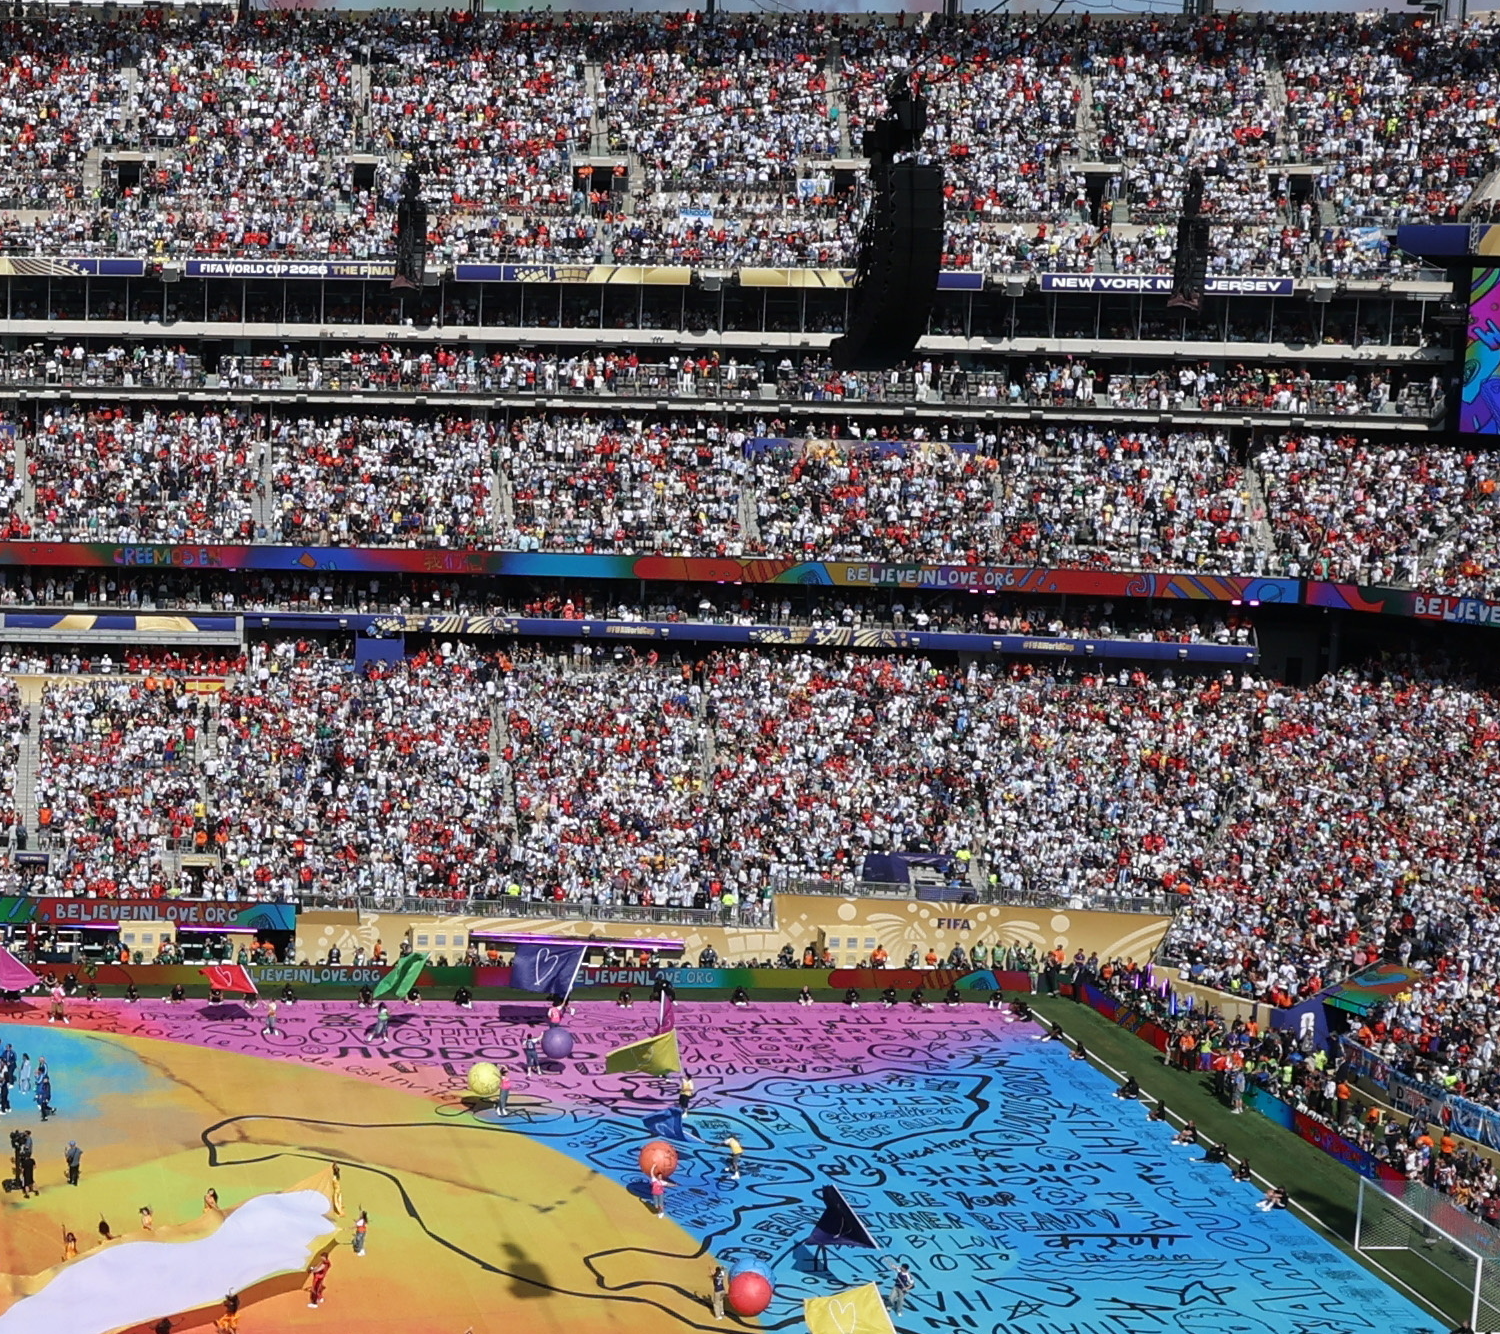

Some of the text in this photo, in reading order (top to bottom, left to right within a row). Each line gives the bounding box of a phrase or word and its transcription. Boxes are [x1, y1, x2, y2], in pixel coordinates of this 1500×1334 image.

[200, 264, 395, 275] FIFA WORLD CUP 2026 THE FINA
[1051, 278, 1094, 288] NEW
[1099, 278, 1153, 289] YORK
[1204, 280, 1281, 291] JERSEY
[845, 566, 1015, 588] BELIEVEINLOVE.ORG
[56, 903, 239, 923] BELIEVEINLOVE.ORG
[937, 917, 972, 931] FIFA
[250, 969, 380, 983] LIEVEINLOVE.ORG
[575, 969, 714, 986] ELIEVEINLOVE.ORG
[766, 1080, 903, 1098] GLOBAL
[793, 1092, 966, 1109] CITIZEN
[971, 1209, 1121, 1232] BEAUTY
[949, 1234, 1018, 1251] LOVE
